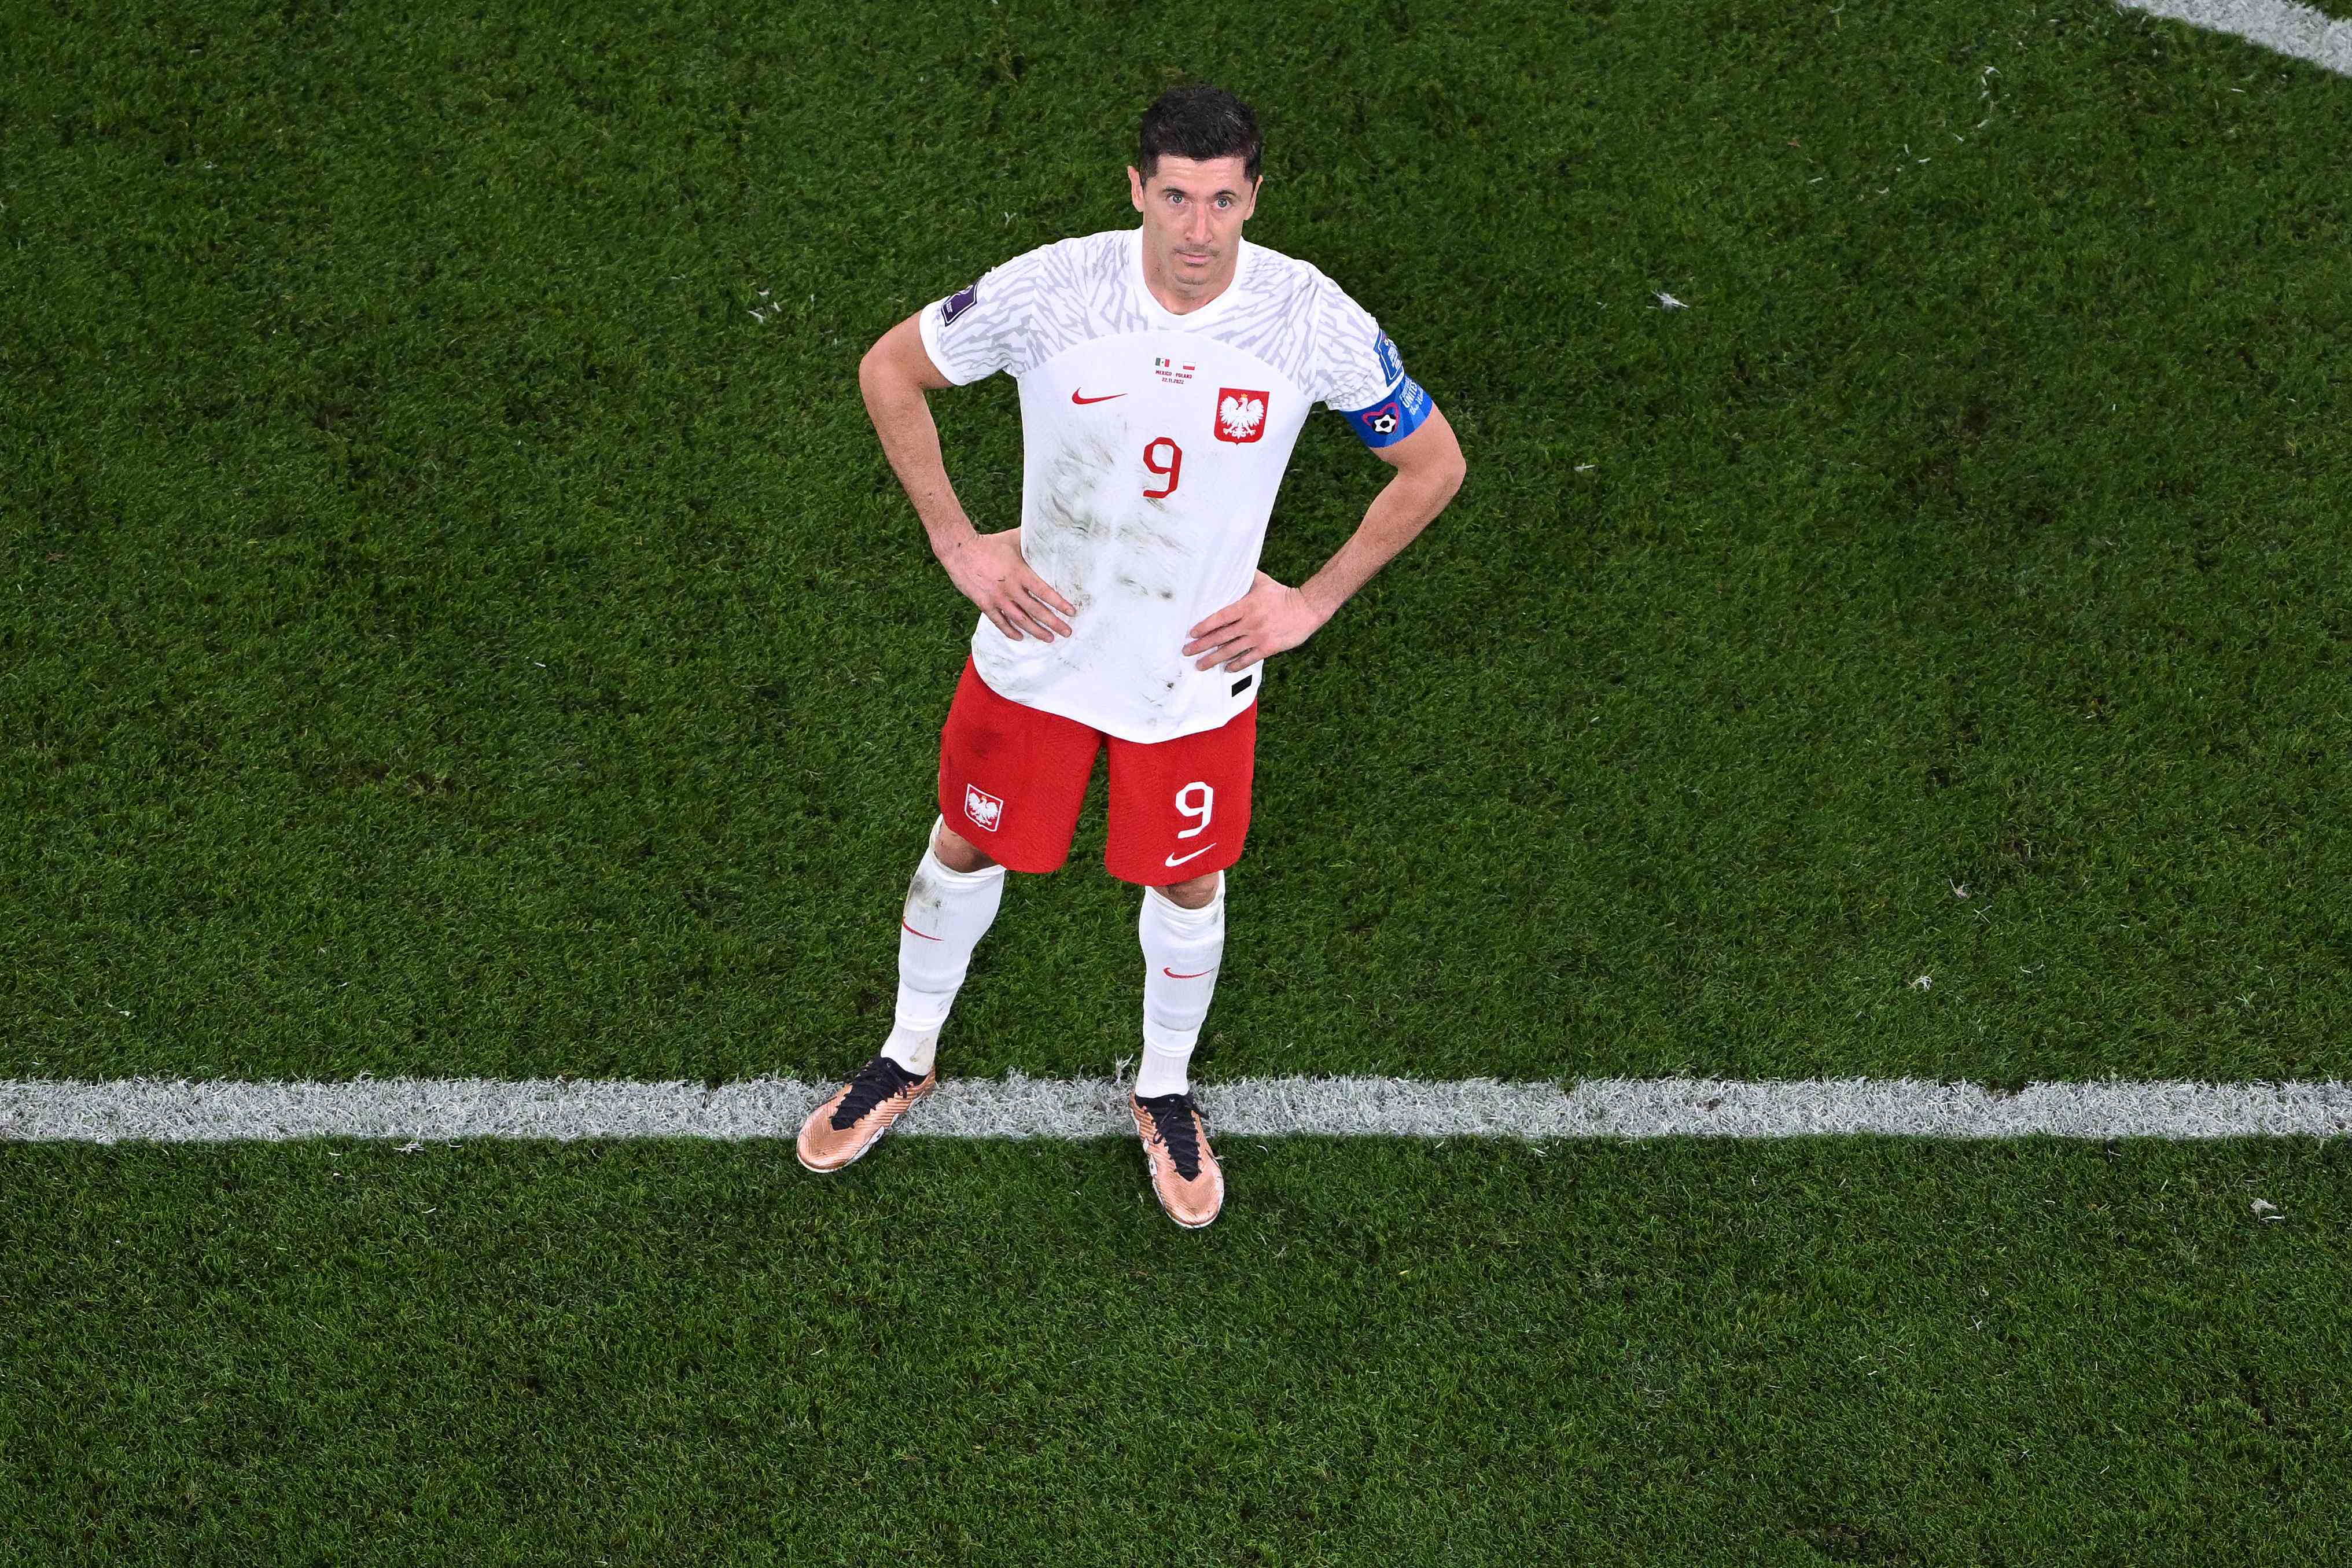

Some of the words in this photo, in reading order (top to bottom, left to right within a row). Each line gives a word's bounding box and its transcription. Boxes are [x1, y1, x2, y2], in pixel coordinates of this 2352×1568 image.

[1403, 382, 1418, 408] UNITES
[1143, 437, 1182, 498] 9
[1176, 782, 1213, 838] 9
